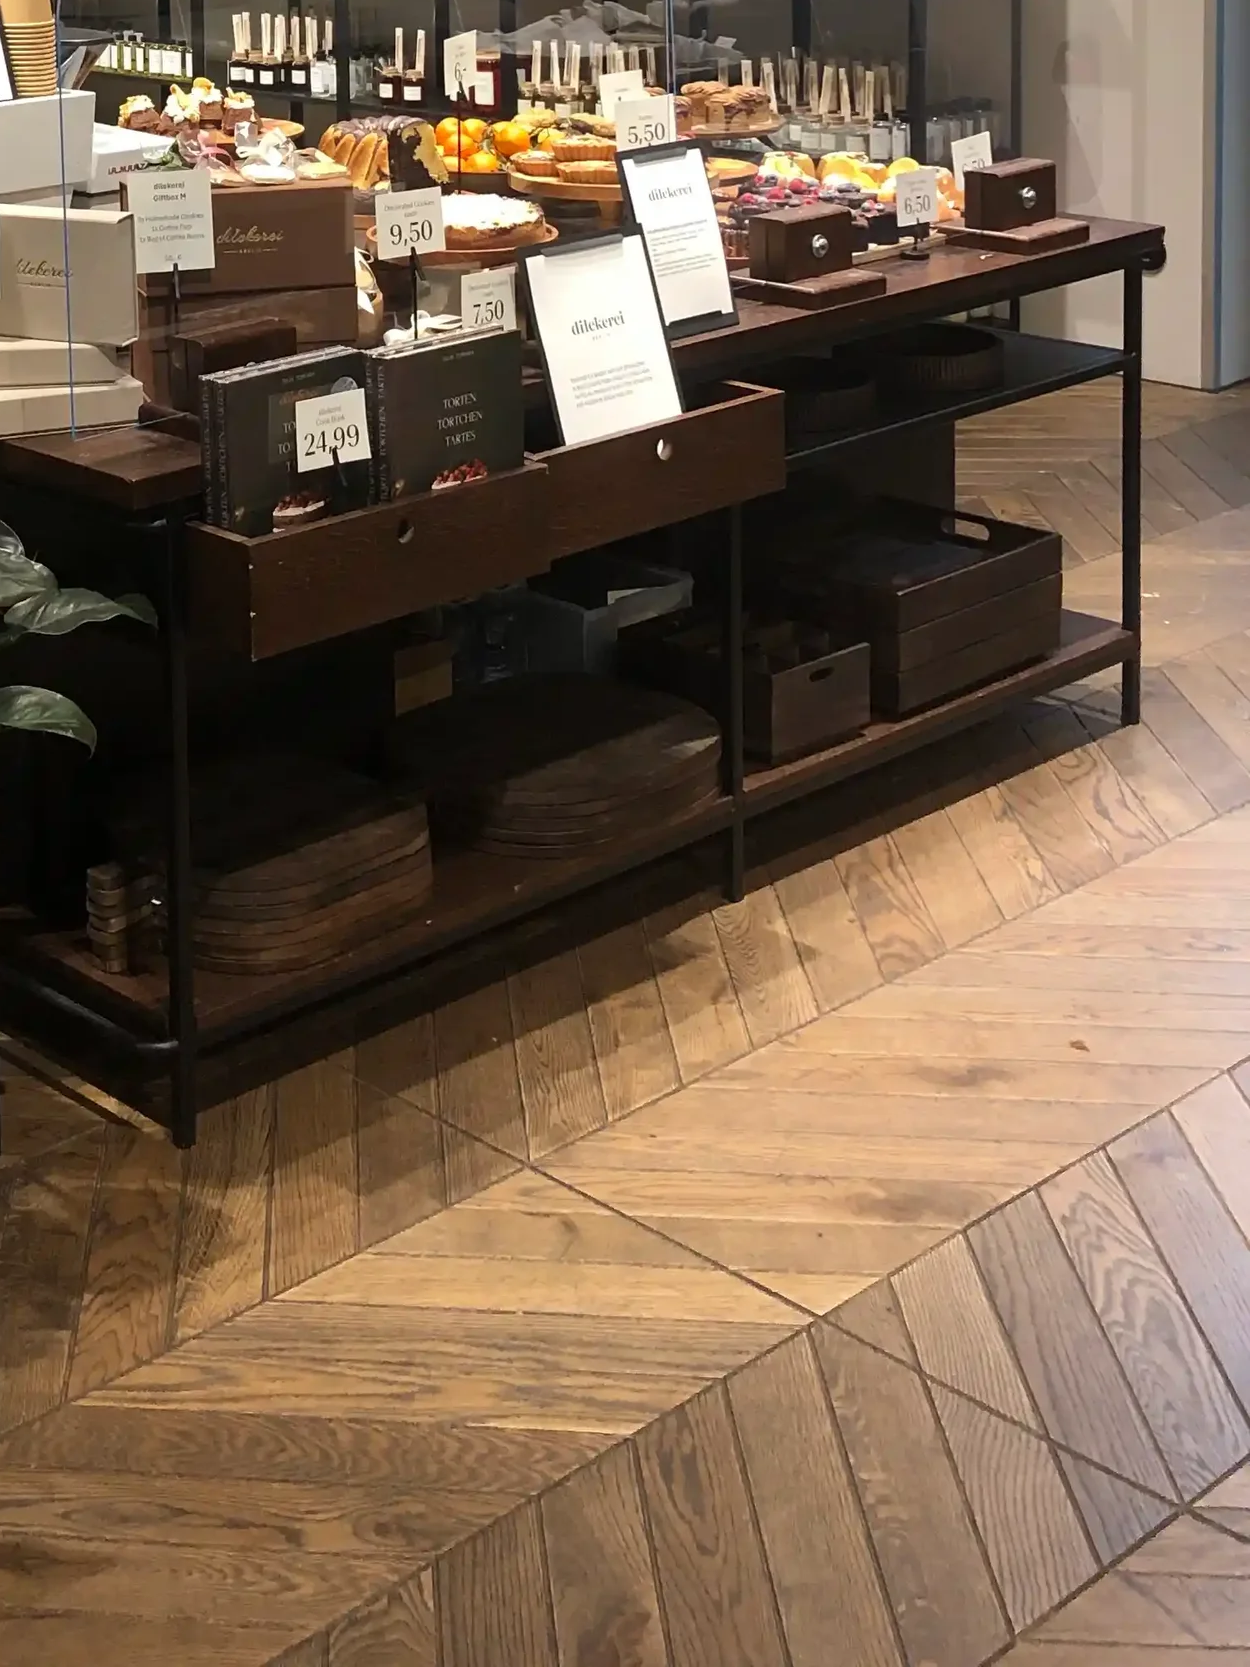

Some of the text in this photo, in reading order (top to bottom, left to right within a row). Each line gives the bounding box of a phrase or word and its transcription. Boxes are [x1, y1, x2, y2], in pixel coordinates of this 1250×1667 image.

[627, 122, 666, 145] 5,50
[153, 192, 187, 202] Giftbox M
[648, 182, 693, 202] dilekerei
[904, 194, 931, 215] 6,50
[389, 219, 433, 247] 9,50
[472, 299, 505, 325] 7,50
[571, 310, 625, 336] dilekerei
[443, 392, 477, 409] TORTEN
[303, 423, 360, 457] 24,99
[444, 430, 476, 448] TARTES
